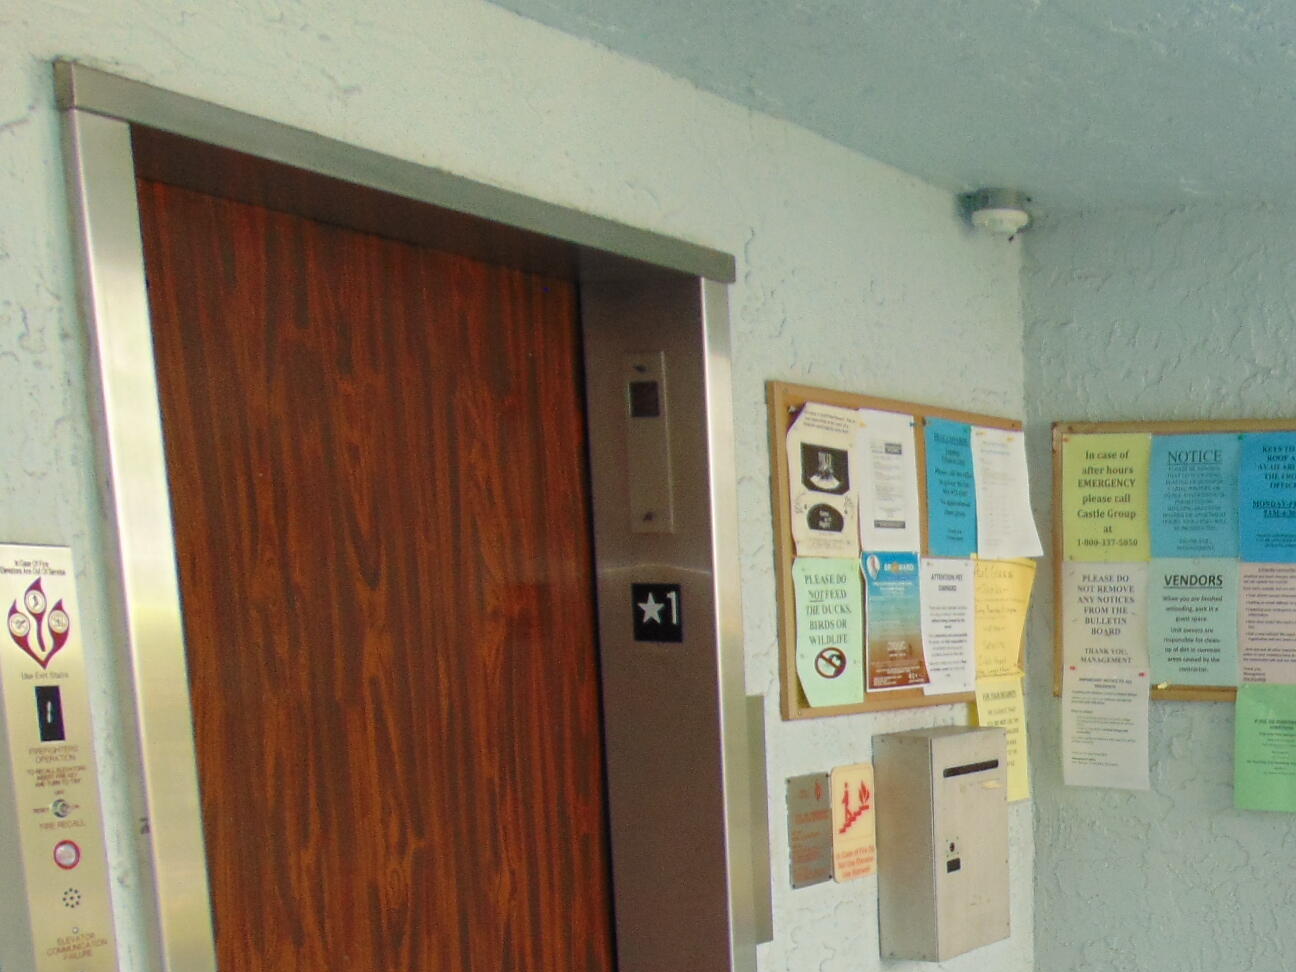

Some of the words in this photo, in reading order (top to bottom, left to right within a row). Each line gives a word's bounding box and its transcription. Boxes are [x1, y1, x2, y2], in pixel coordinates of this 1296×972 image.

[1085, 450, 1095, 460] In
[1097, 451, 1117, 460] case
[1119, 450, 1129, 460] of
[1167, 450, 1223, 463] NOTICE
[1082, 466, 1104, 475] after
[1106, 465, 1134, 475] hours
[1077, 479, 1136, 488] EMERGENCY
[1082, 494, 1112, 505] please
[1114, 493, 1131, 503] call
[1077, 509, 1105, 518] Castle
[1107, 509, 1137, 520] Group
[1103, 525, 1113, 533] at
[804, 575, 833, 585] PLEASE
[835, 574, 847, 584] DO
[1082, 575, 1114, 583] PLEASE
[1116, 575, 1129, 583] DO
[1164, 574, 1223, 586] VENDORS
[825, 589, 847, 599] FEED
[1077, 585, 1095, 593] NOT
[1097, 585, 1135, 593] REMOVE
[1078, 596, 1095, 604] ANY
[1097, 596, 1136, 604] NOTICES
[666, 590, 678, 625] 1
[1084, 606, 1109, 614] FROM
[1111, 606, 1128, 614] THE
[809, 620, 835, 630] BIRDS
[836, 619, 847, 629] OR
[1085, 617, 1127, 625] BULLETIN
[1091, 628, 1121, 636] BOARD
[808, 634, 848, 646] WILDLIFE
